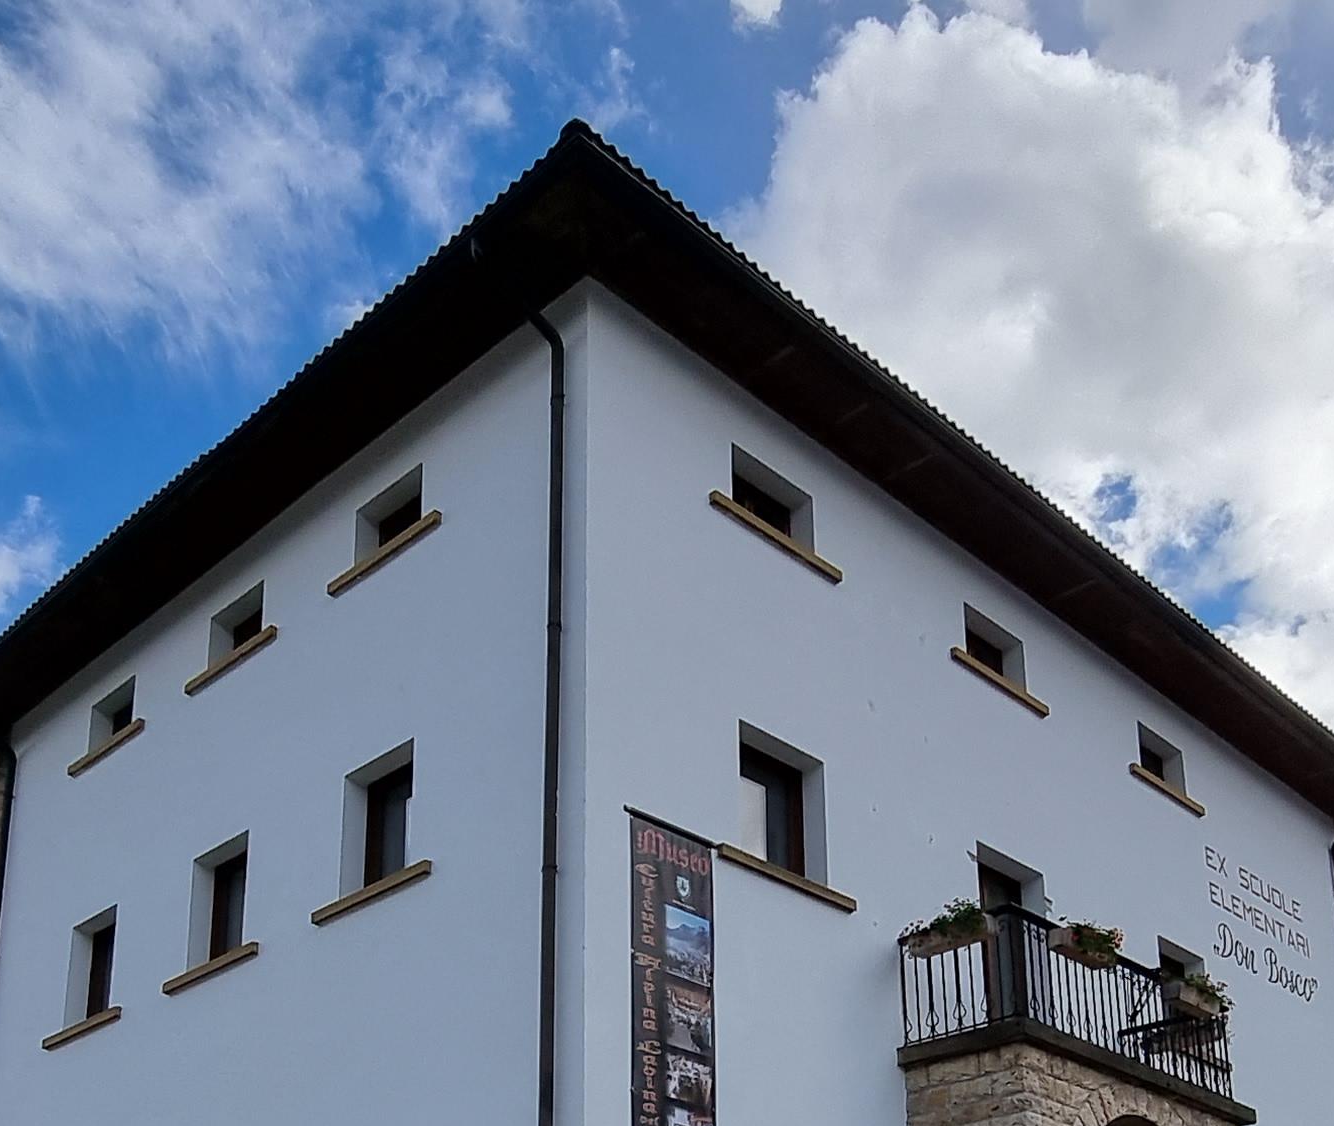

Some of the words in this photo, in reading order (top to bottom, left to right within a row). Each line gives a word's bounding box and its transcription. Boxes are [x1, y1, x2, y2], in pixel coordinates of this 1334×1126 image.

[636, 828, 710, 876] Museo
[1204, 845, 1229, 878] EX
[1238, 866, 1303, 923] SCUOLE
[1208, 881, 1311, 959] ELEMENTARI
